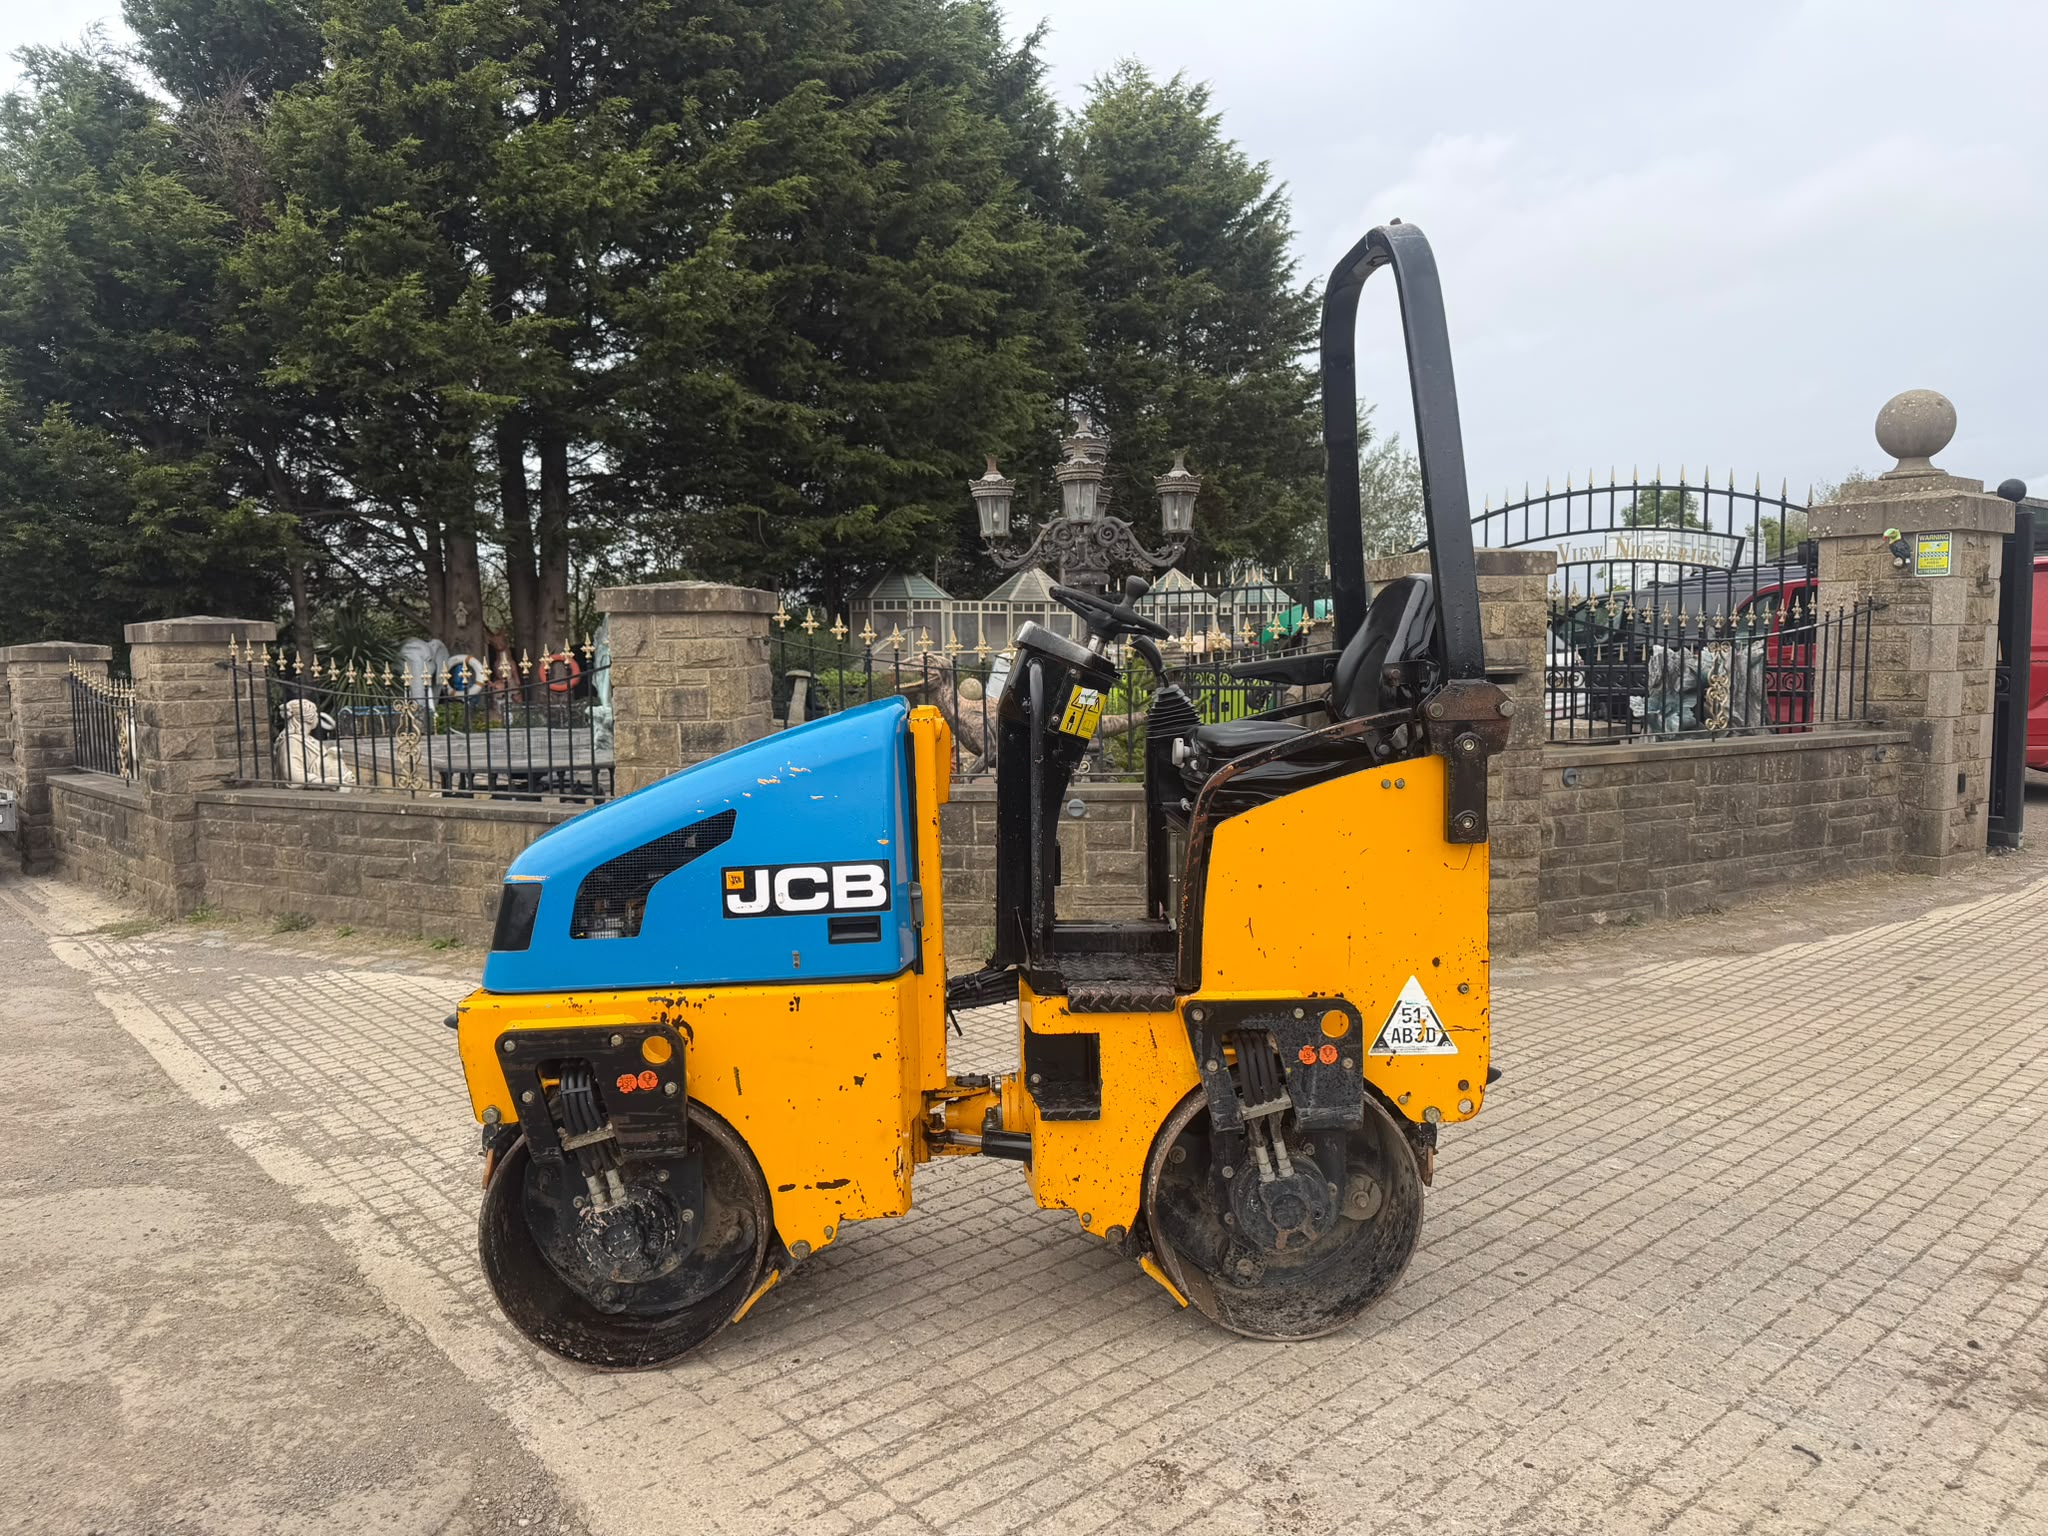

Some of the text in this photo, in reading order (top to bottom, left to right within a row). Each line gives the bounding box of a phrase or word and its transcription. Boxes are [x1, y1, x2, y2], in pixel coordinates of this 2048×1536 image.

[1557, 536, 1722, 566] VIEW NURSERIES
[726, 864, 887, 914] JCB
[1402, 1007, 1421, 1024] 51
